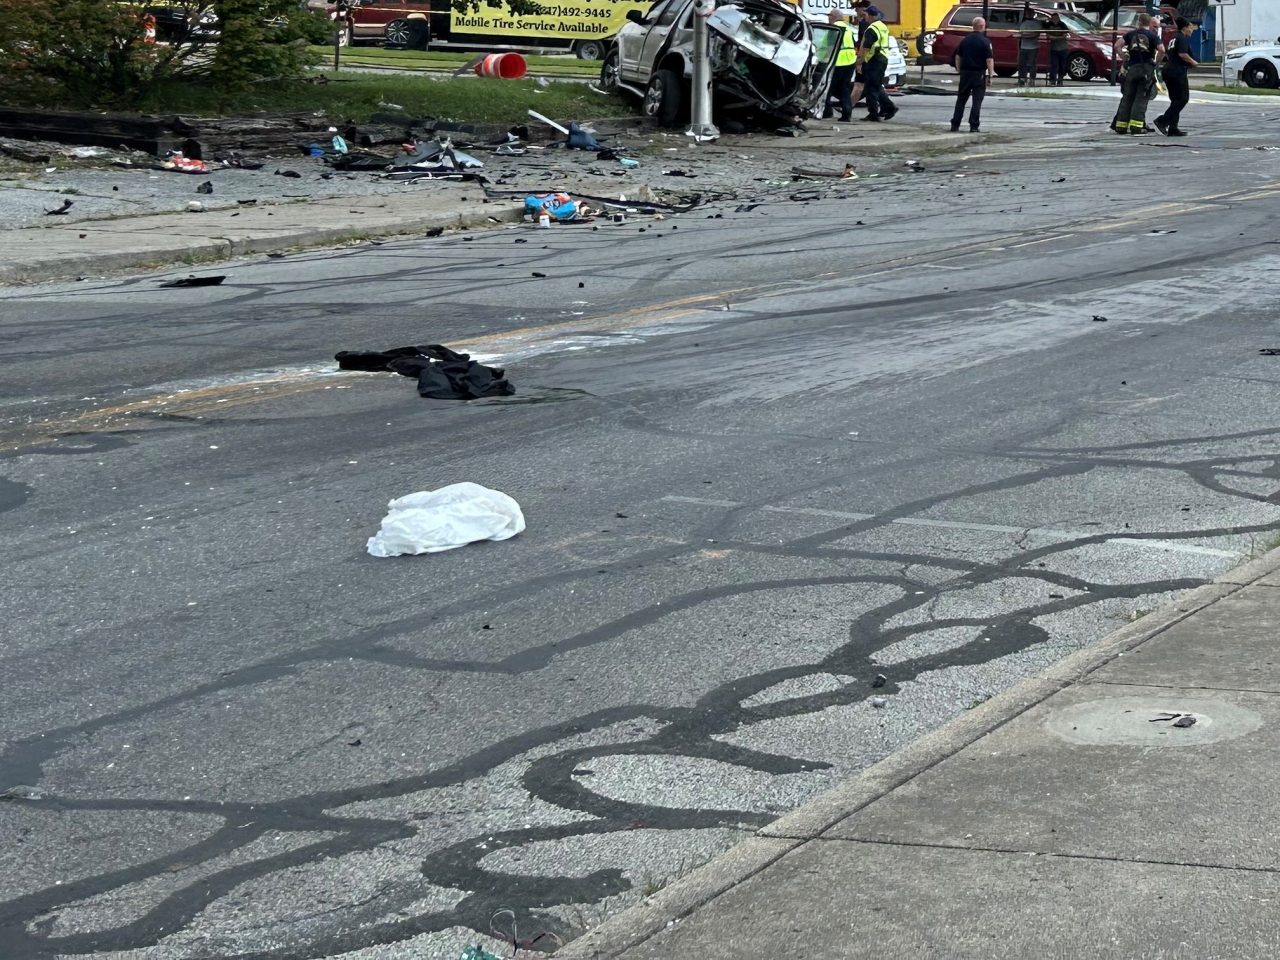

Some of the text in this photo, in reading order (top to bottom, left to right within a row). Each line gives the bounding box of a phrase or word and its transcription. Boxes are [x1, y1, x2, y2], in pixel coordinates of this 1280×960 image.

[455, 16, 609, 33] Mobile Tire Service Available
